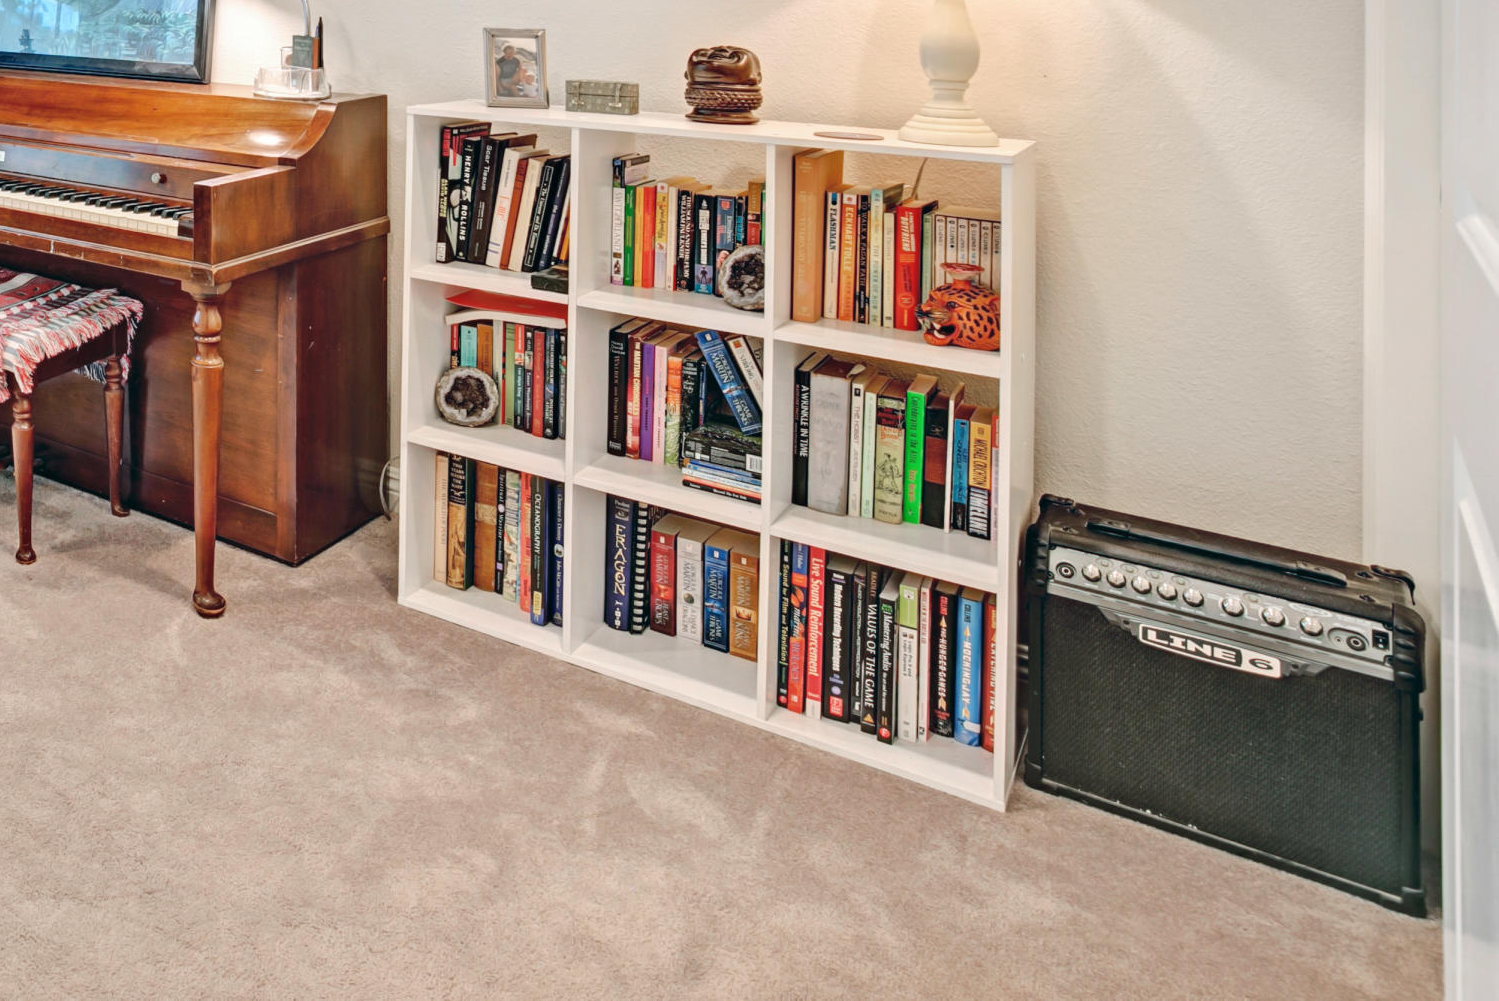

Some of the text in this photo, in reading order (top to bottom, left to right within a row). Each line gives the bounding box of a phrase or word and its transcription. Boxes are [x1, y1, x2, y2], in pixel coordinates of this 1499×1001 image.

[484, 145, 493, 164] Scar
[480, 165, 490, 191] Tissue
[459, 155, 472, 241] HENRY ROLLINS
[614, 192, 623, 252] SWITZERLAND
[829, 207, 838, 251] FLASHMAN
[844, 206, 854, 245] ECKHART
[900, 217, 910, 251] BOYFRIEND
[844, 247, 853, 272] TOLLE
[710, 352, 729, 384] MARTIN
[800, 393, 809, 426] WRINKLE
[910, 396, 920, 430] Confederates
[800, 428, 808, 437] IN
[800, 439, 808, 457] TIME
[909, 450, 919, 463] Attic
[972, 439, 988, 486] MICHAEL CRICHTON
[533, 493, 542, 554] OCEANOGRAPHY
[969, 488, 988, 536] TIMELINE
[614, 524, 626, 596] ERAGON
[655, 554, 663, 584] MARTIN
[781, 564, 789, 586] Sound
[683, 562, 691, 591] MARTIN
[709, 569, 718, 599] MARTIN
[737, 576, 745, 605] MARTIN
[781, 597, 789, 613] Film
[809, 558, 824, 677] Live Sound Reinforcement
[866, 604, 877, 638] VALUES
[940, 596, 948, 615] COLLINS
[832, 583, 844, 671] Modern Recording Techniques
[880, 615, 892, 650] Mastering
[780, 626, 788, 661] Television
[790, 607, 801, 683] marine BIOLOGY
[866, 641, 876, 653] OF
[1146, 629, 1273, 671] LINE 6
[865, 657, 875, 677] THE
[882, 651, 892, 671] Audio
[962, 641, 972, 704] MOCKINGJAY
[864, 679, 875, 707] GAME
[938, 671, 947, 697] GAMES
